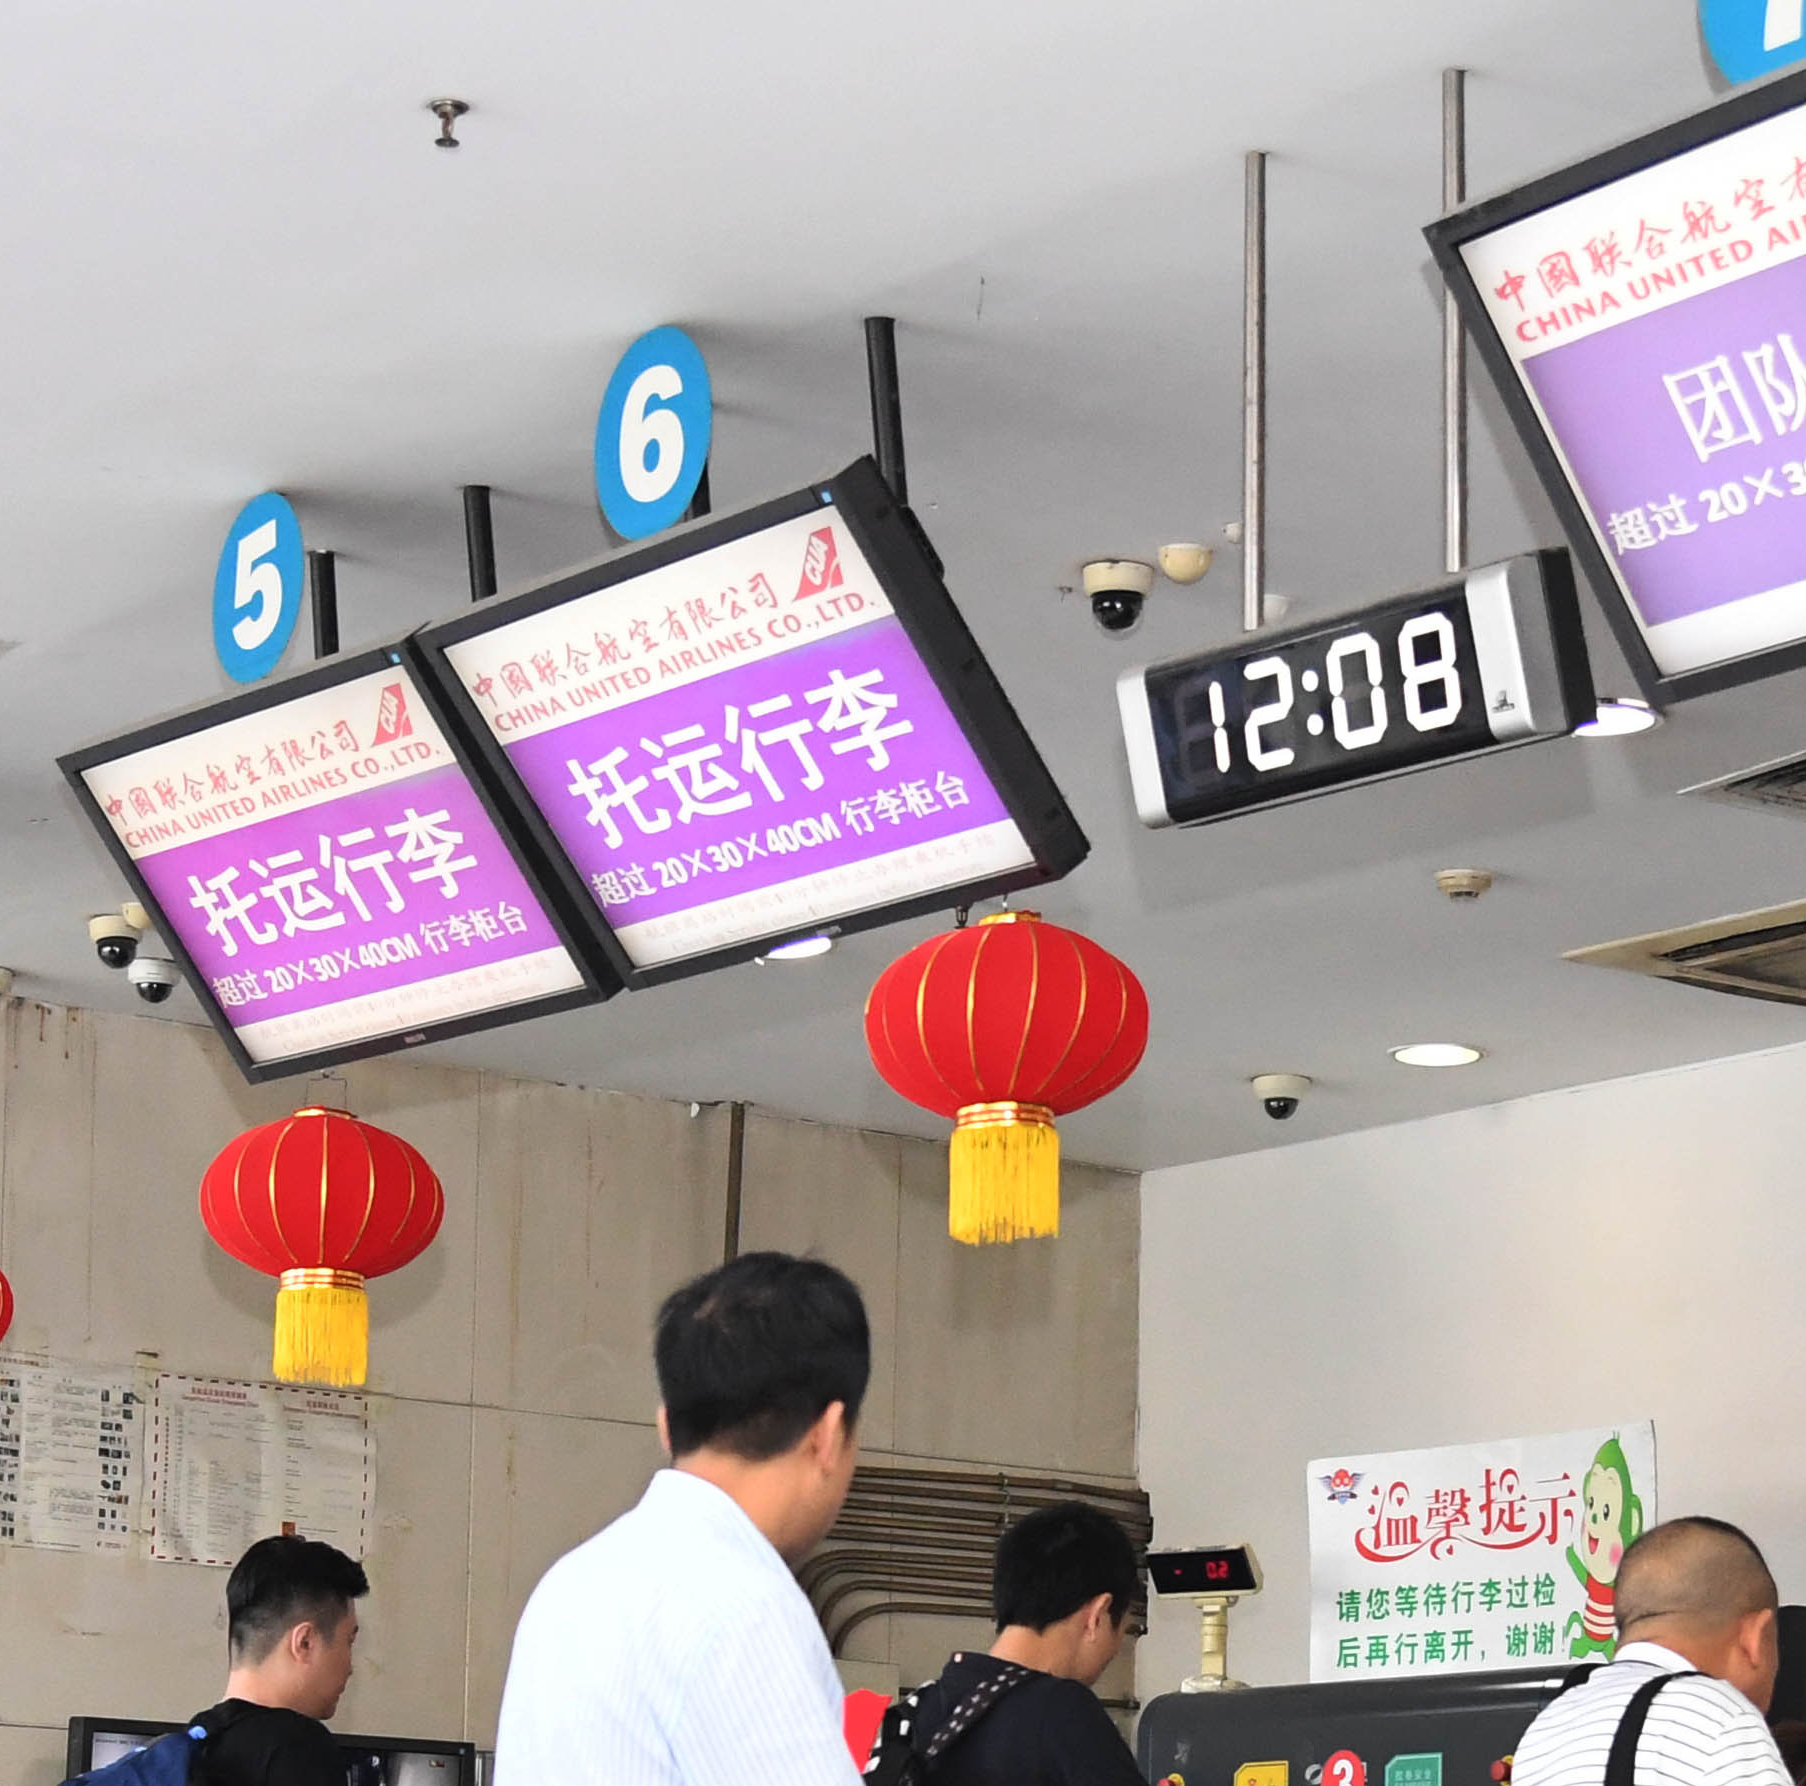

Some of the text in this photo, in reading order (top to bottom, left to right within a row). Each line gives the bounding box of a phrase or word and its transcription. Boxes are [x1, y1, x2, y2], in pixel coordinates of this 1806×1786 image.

[1516, 290, 1621, 342] CHINA
[1627, 239, 1754, 300] UNITED
[619, 364, 685, 503] 6
[1606, 492, 1700, 556] 超过
[232, 518, 282, 650] 5
[495, 696, 566, 733] CHINA
[573, 664, 652, 707] UNITED
[658, 628, 761, 677] AIRLINES
[1208, 612, 1462, 773] 12:08
[124, 819, 186, 850] CHINA
[188, 793, 256, 829] UNITED
[261, 766, 348, 809] AIRLINES
[567, 668, 913, 851] 托运行李
[188, 807, 478, 958] 托运行李
[590, 863, 657, 910] 超过
[840, 771, 971, 837] 行李柜台
[212, 968, 268, 1009] 超过
[419, 901, 529, 956] 行李柜台
[1355, 1468, 1576, 1562] 温馨提示
[1336, 1573, 1556, 1623] 请您等待行李过检
